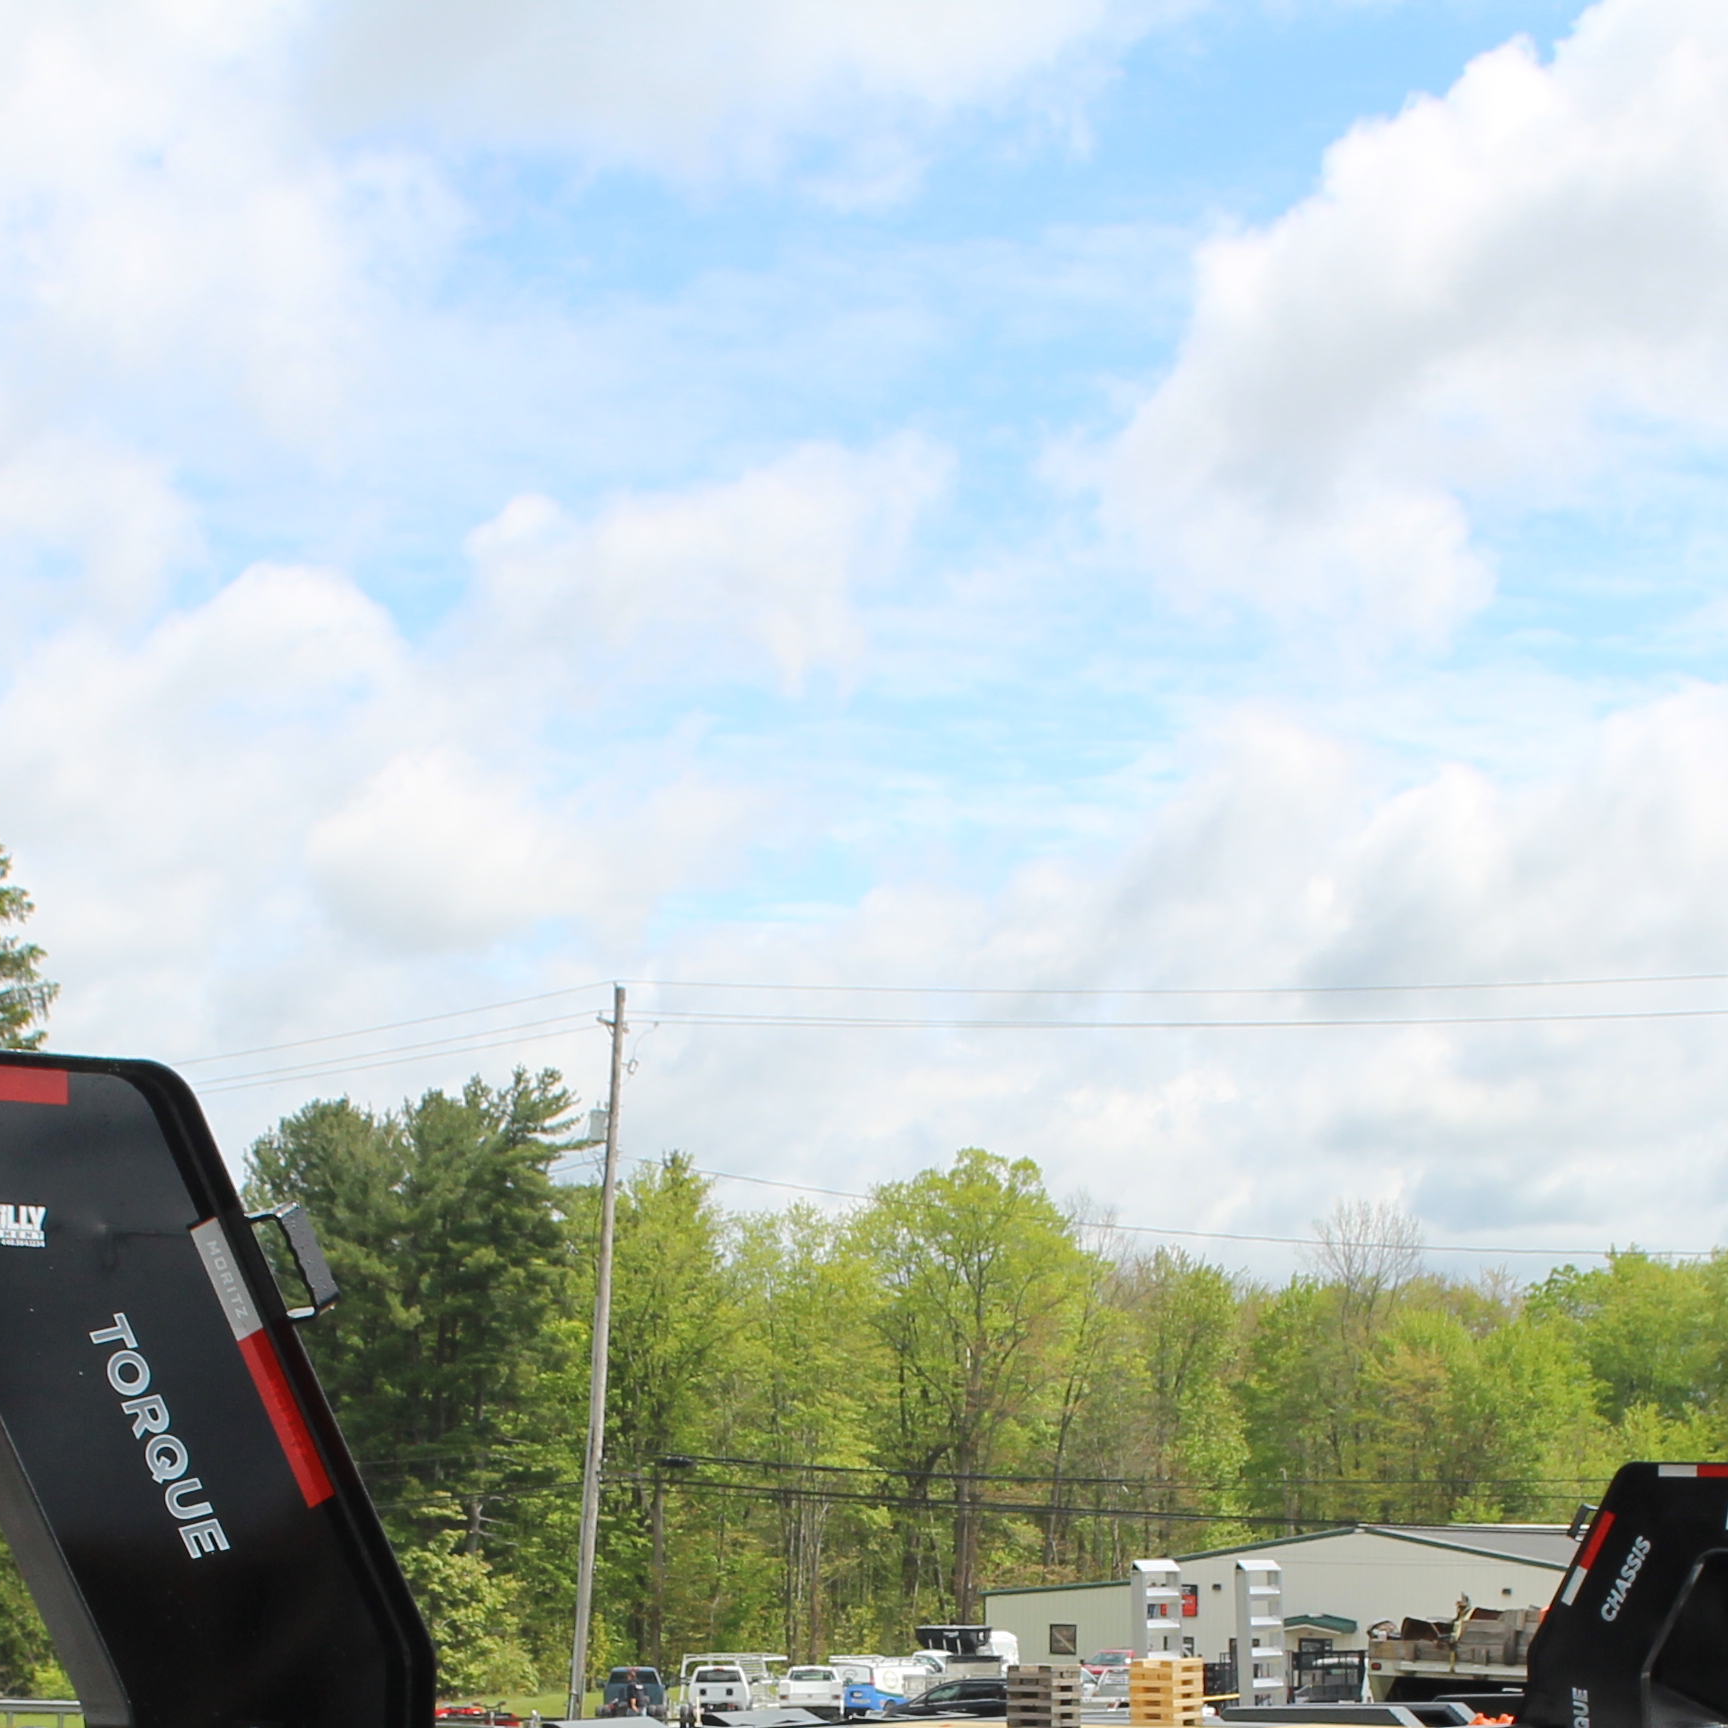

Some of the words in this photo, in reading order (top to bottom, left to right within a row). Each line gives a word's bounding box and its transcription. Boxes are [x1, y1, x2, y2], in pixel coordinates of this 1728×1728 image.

[206, 1239, 250, 1320] MORITZ
[88, 1312, 231, 1560] TORQUE
[1600, 1535, 1652, 1623] CHASSIS
